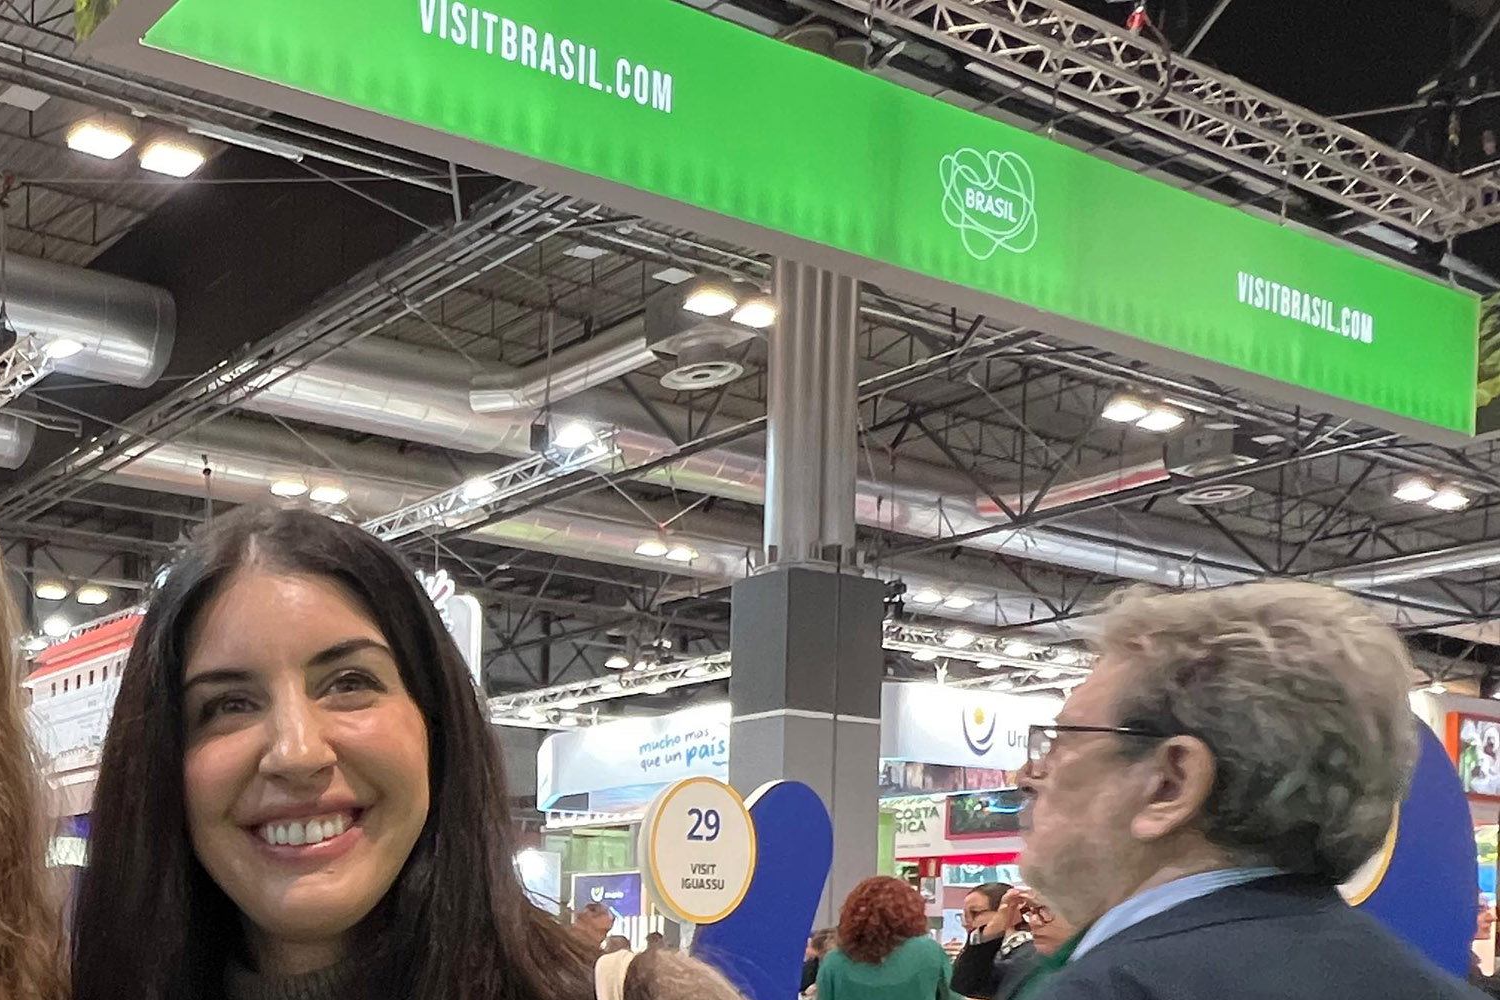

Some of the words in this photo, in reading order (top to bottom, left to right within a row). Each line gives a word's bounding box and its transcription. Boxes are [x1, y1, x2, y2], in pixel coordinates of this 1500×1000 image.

[419, 0, 672, 113] VISITBRASIL.COM
[965, 187, 1017, 223] BRASIL
[1238, 271, 1373, 344] VISITBRASIL.COM
[641, 756, 661, 773] que
[665, 752, 682, 764] un
[686, 736, 725, 768] país
[687, 808, 720, 841] 29
[681, 878, 725, 890] IGUASSU
[690, 863, 717, 875] VISIT
